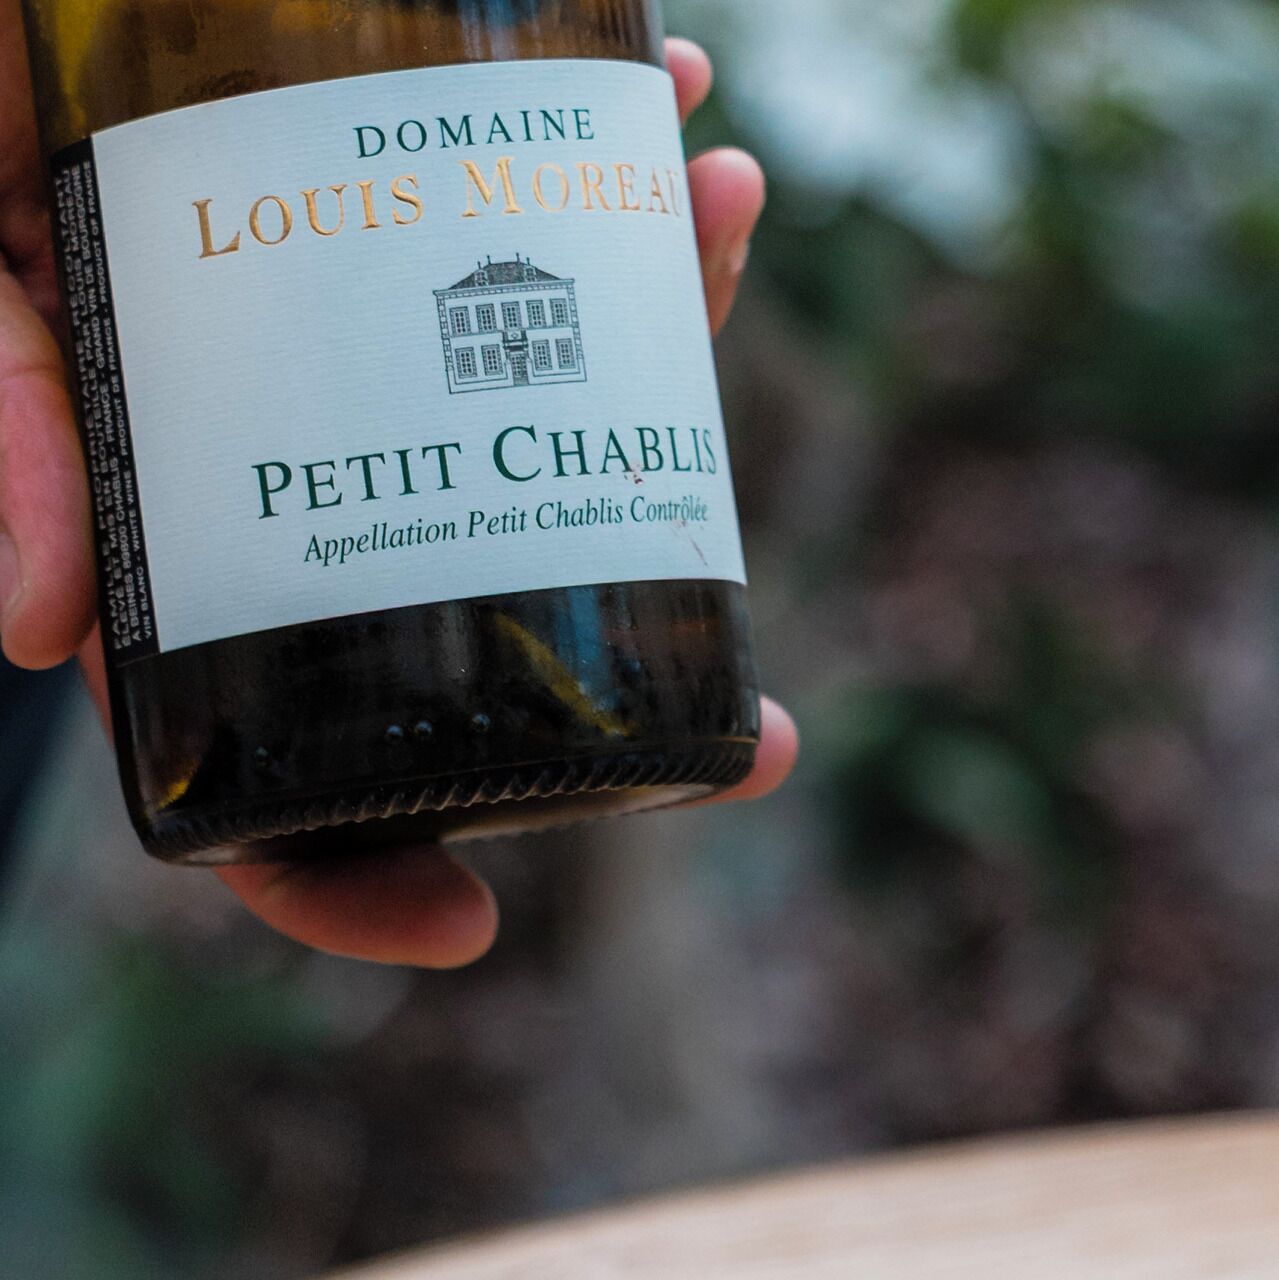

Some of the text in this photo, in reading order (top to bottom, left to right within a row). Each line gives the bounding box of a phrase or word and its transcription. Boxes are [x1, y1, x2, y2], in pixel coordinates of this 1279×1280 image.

[353, 108, 595, 159] DOMAINE
[72, 165, 91, 259] BOURGOGNE
[83, 161, 96, 213] FRANCE
[192, 175, 422, 259] LOUIS
[94, 241, 107, 302] PRODUCT
[88, 288, 98, 312] VIN
[91, 316, 105, 368] GRAND
[104, 318, 116, 370] FRANCE
[100, 383, 115, 442] FRANCE
[115, 399, 128, 455] PRODUIT
[124, 470, 134, 504] WINE
[251, 425, 717, 519] PETIT CHABLIS
[129, 509, 141, 551] WHITE
[304, 494, 708, 566] Appellation Petit Chablis Contrôlée
[143, 616, 152, 637] VIN
